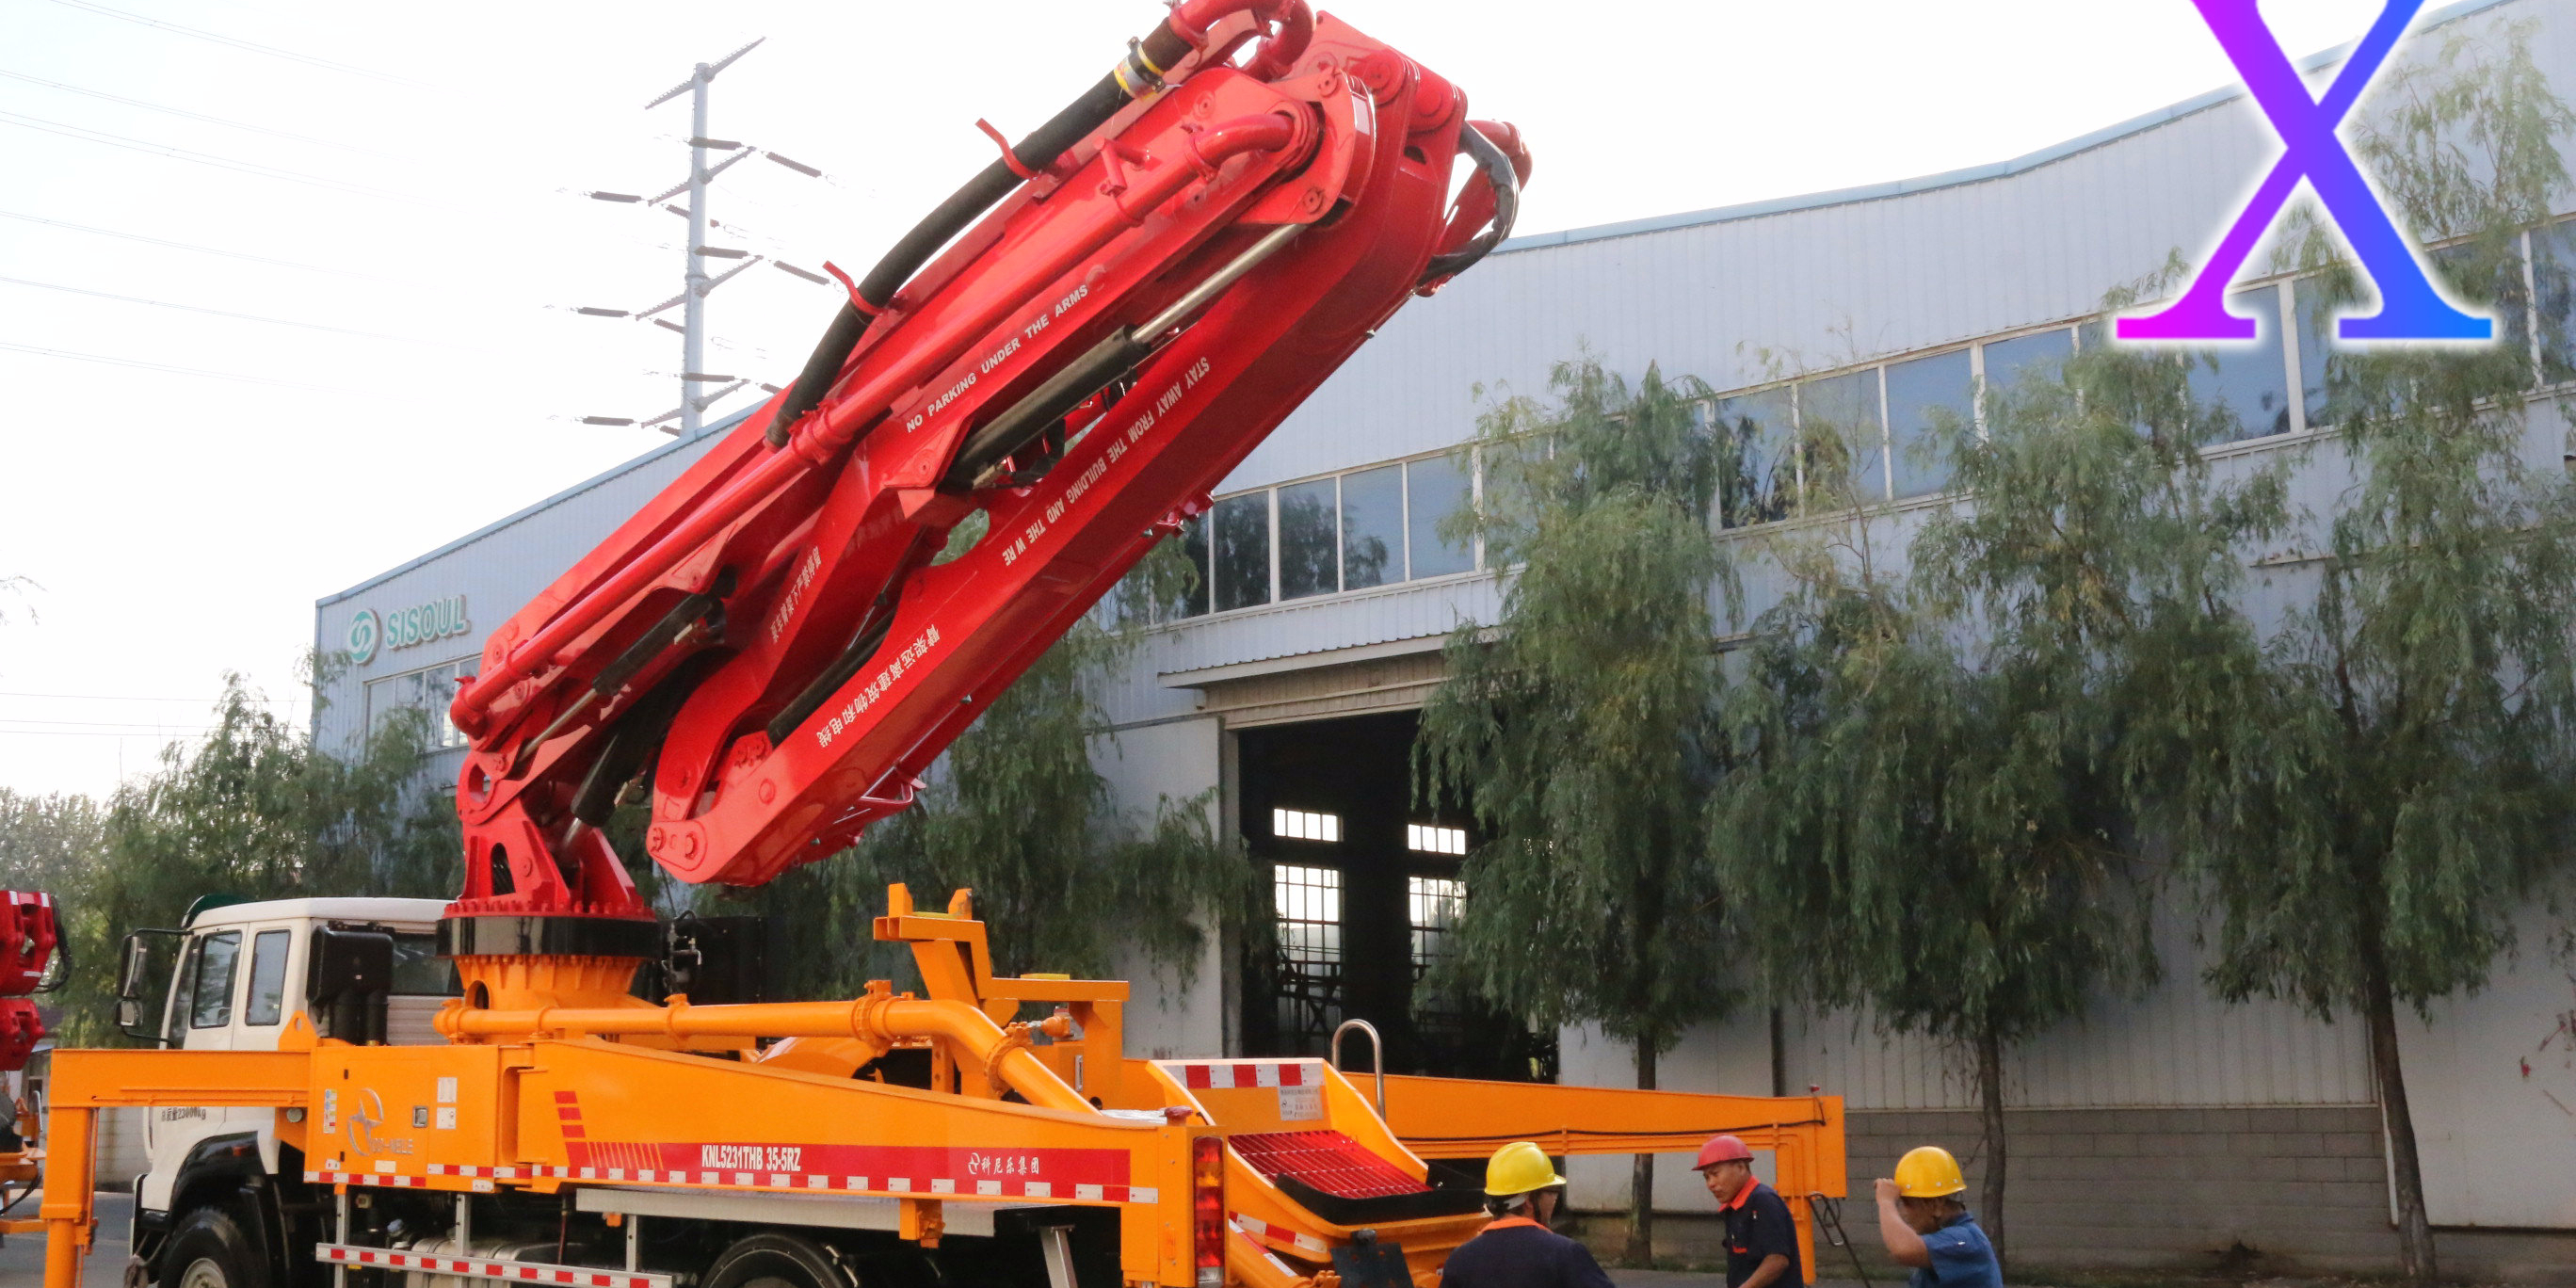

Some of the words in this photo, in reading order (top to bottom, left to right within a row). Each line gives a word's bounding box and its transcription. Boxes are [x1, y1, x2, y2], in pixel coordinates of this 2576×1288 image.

[906, 414, 924, 433] NO
[927, 372, 977, 417] PARKING
[981, 338, 1021, 374] UNDER
[1024, 314, 1050, 339] THE
[1054, 284, 1088, 317] ARMS
[1184, 357, 1210, 389] STAY
[1156, 381, 1183, 418] AWAY
[1128, 411, 1155, 443] FROM
[1106, 438, 1128, 463] THE
[1066, 457, 1107, 505] BUILDING
[1046, 497, 1065, 523] AND
[1025, 519, 1047, 543] THE
[386, 595, 470, 651] SISOUL
[815, 624, 941, 748] 臂架远离建筑物和电线
[701, 1144, 764, 1170] KNL5231THB
[766, 1147, 801, 1171] 35-5RZ
[981, 1155, 1039, 1175] 科尼乐集团
